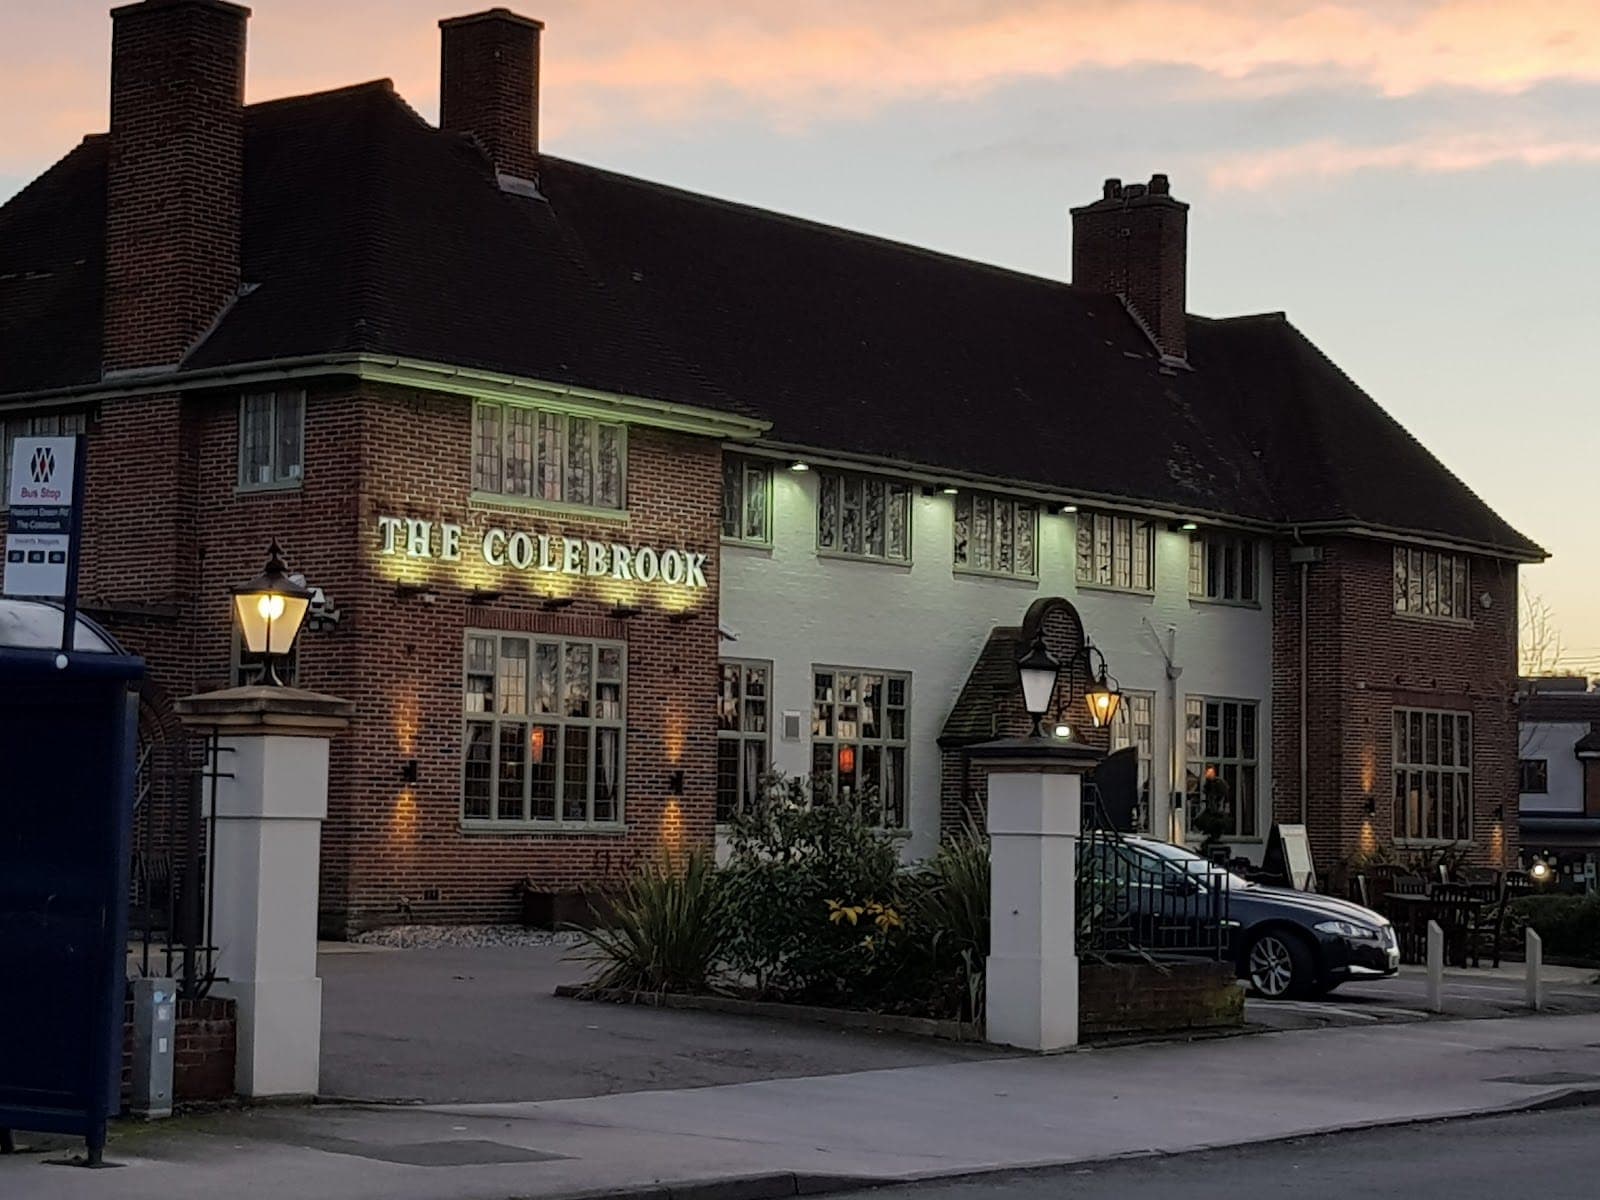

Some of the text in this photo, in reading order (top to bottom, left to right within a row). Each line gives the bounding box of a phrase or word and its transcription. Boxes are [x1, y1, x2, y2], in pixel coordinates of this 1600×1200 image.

[21, 487, 61, 501] Bus Stop
[378, 516, 708, 588] THE COLEBROOK
